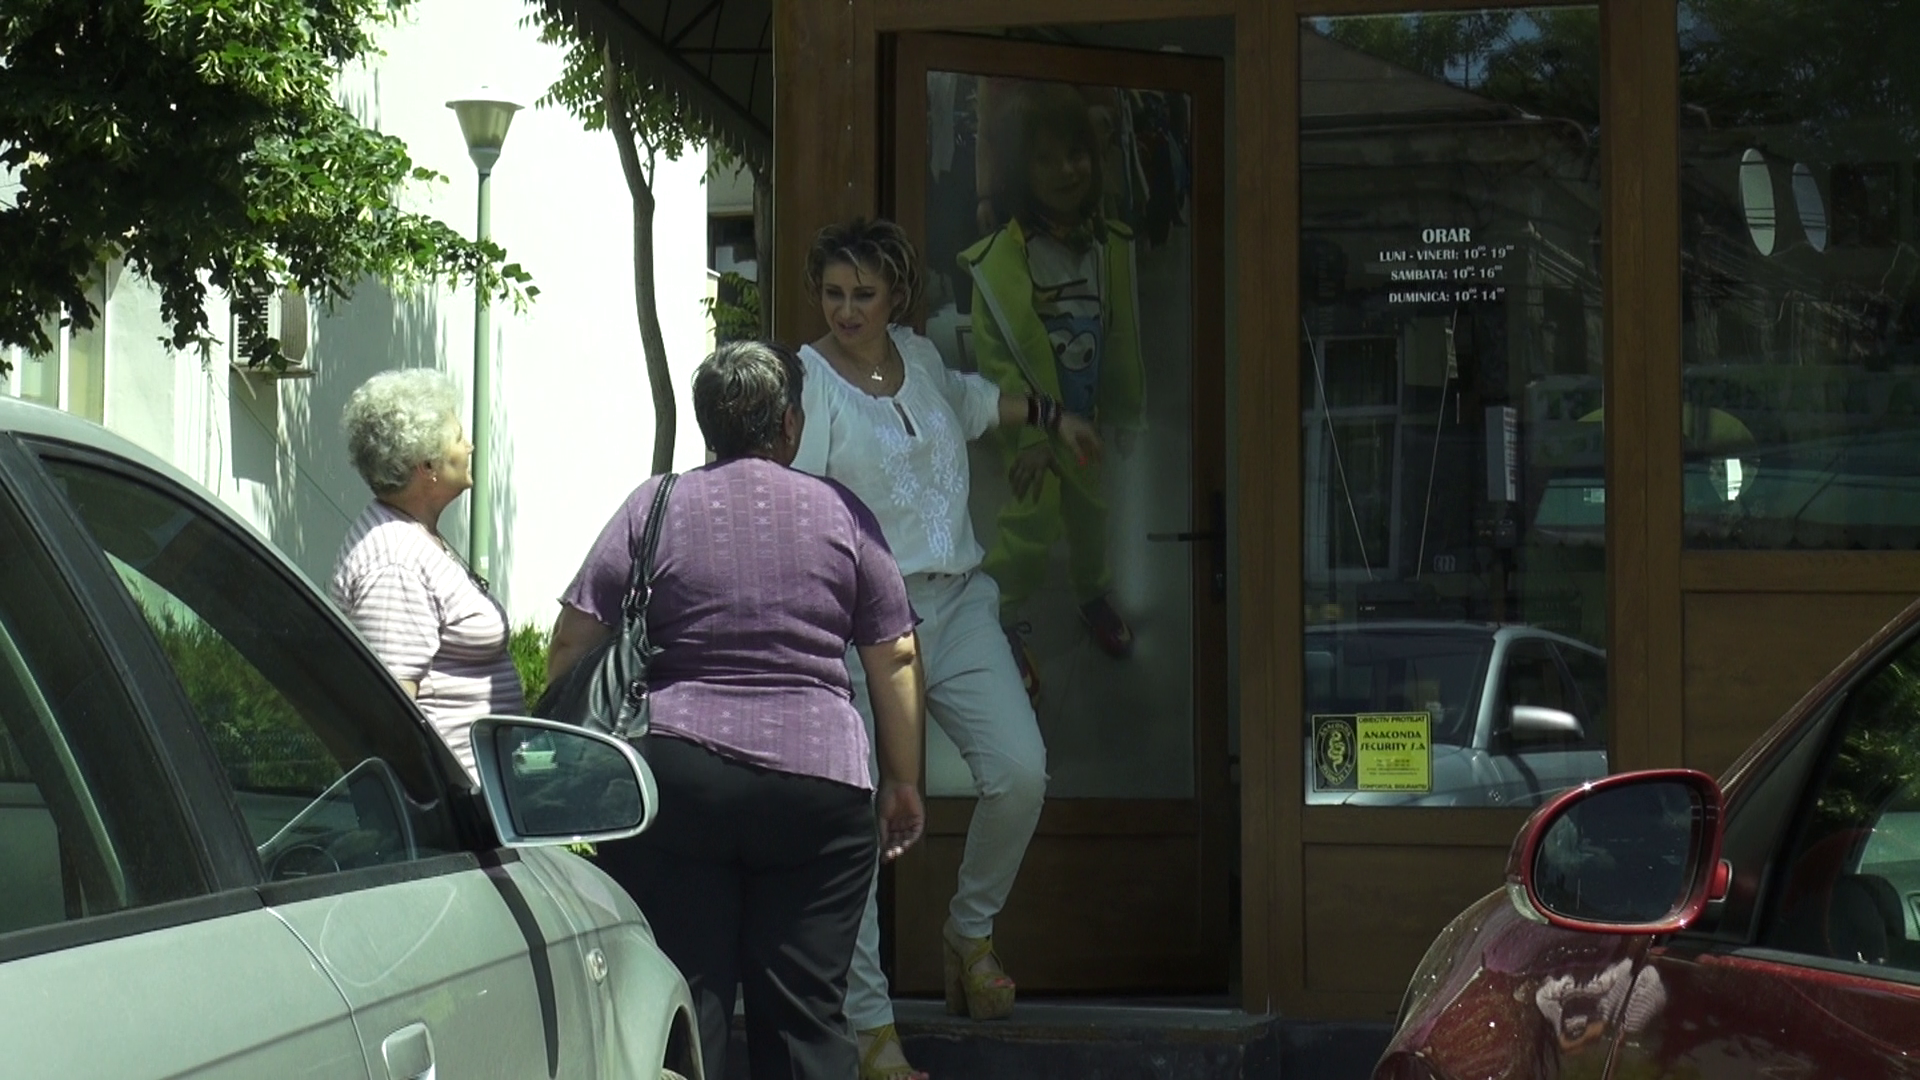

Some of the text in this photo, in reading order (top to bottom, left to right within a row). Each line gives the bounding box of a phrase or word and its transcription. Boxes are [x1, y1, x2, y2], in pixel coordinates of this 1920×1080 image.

[1422, 228, 1471, 243] ORAR
[1379, 251, 1406, 262] LUNI
[1416, 249, 1459, 260] VINERI:
[1391, 269, 1448, 281] SAMBATA:
[1388, 291, 1450, 303] DUMINICA:
[1363, 731, 1422, 739] ANACONDA
[1360, 742, 1407, 751] SECURITY
